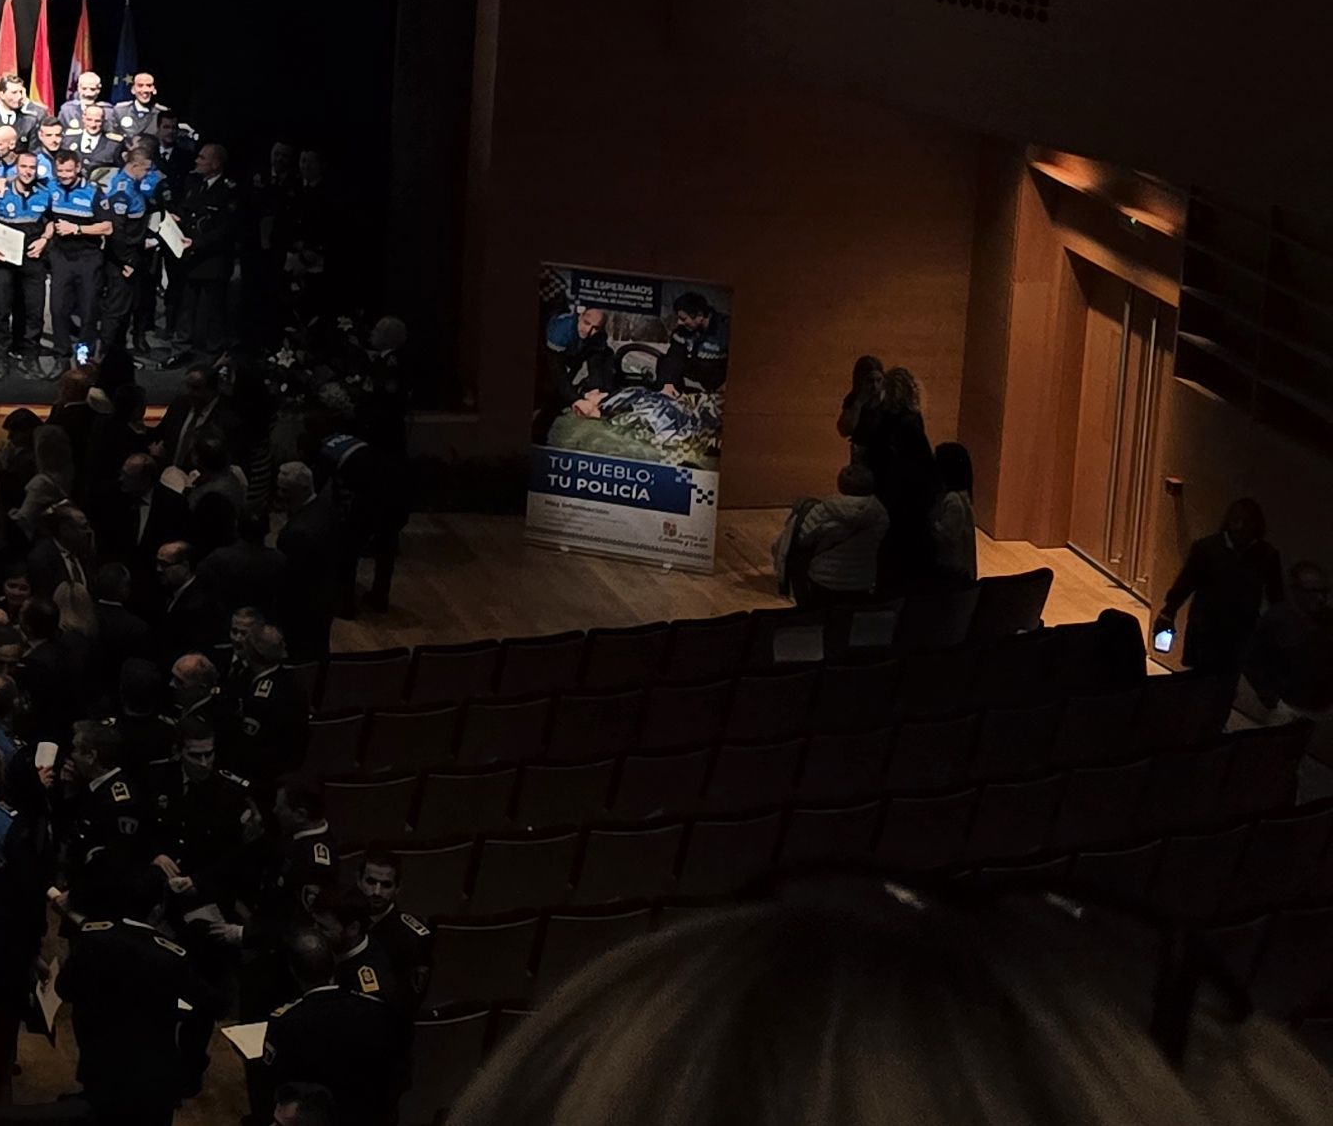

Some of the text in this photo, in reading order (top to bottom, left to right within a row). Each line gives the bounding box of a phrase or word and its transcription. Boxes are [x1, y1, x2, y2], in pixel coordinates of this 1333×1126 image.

[548, 455, 573, 472] TU
[547, 474, 651, 502] TU POLICÍA
